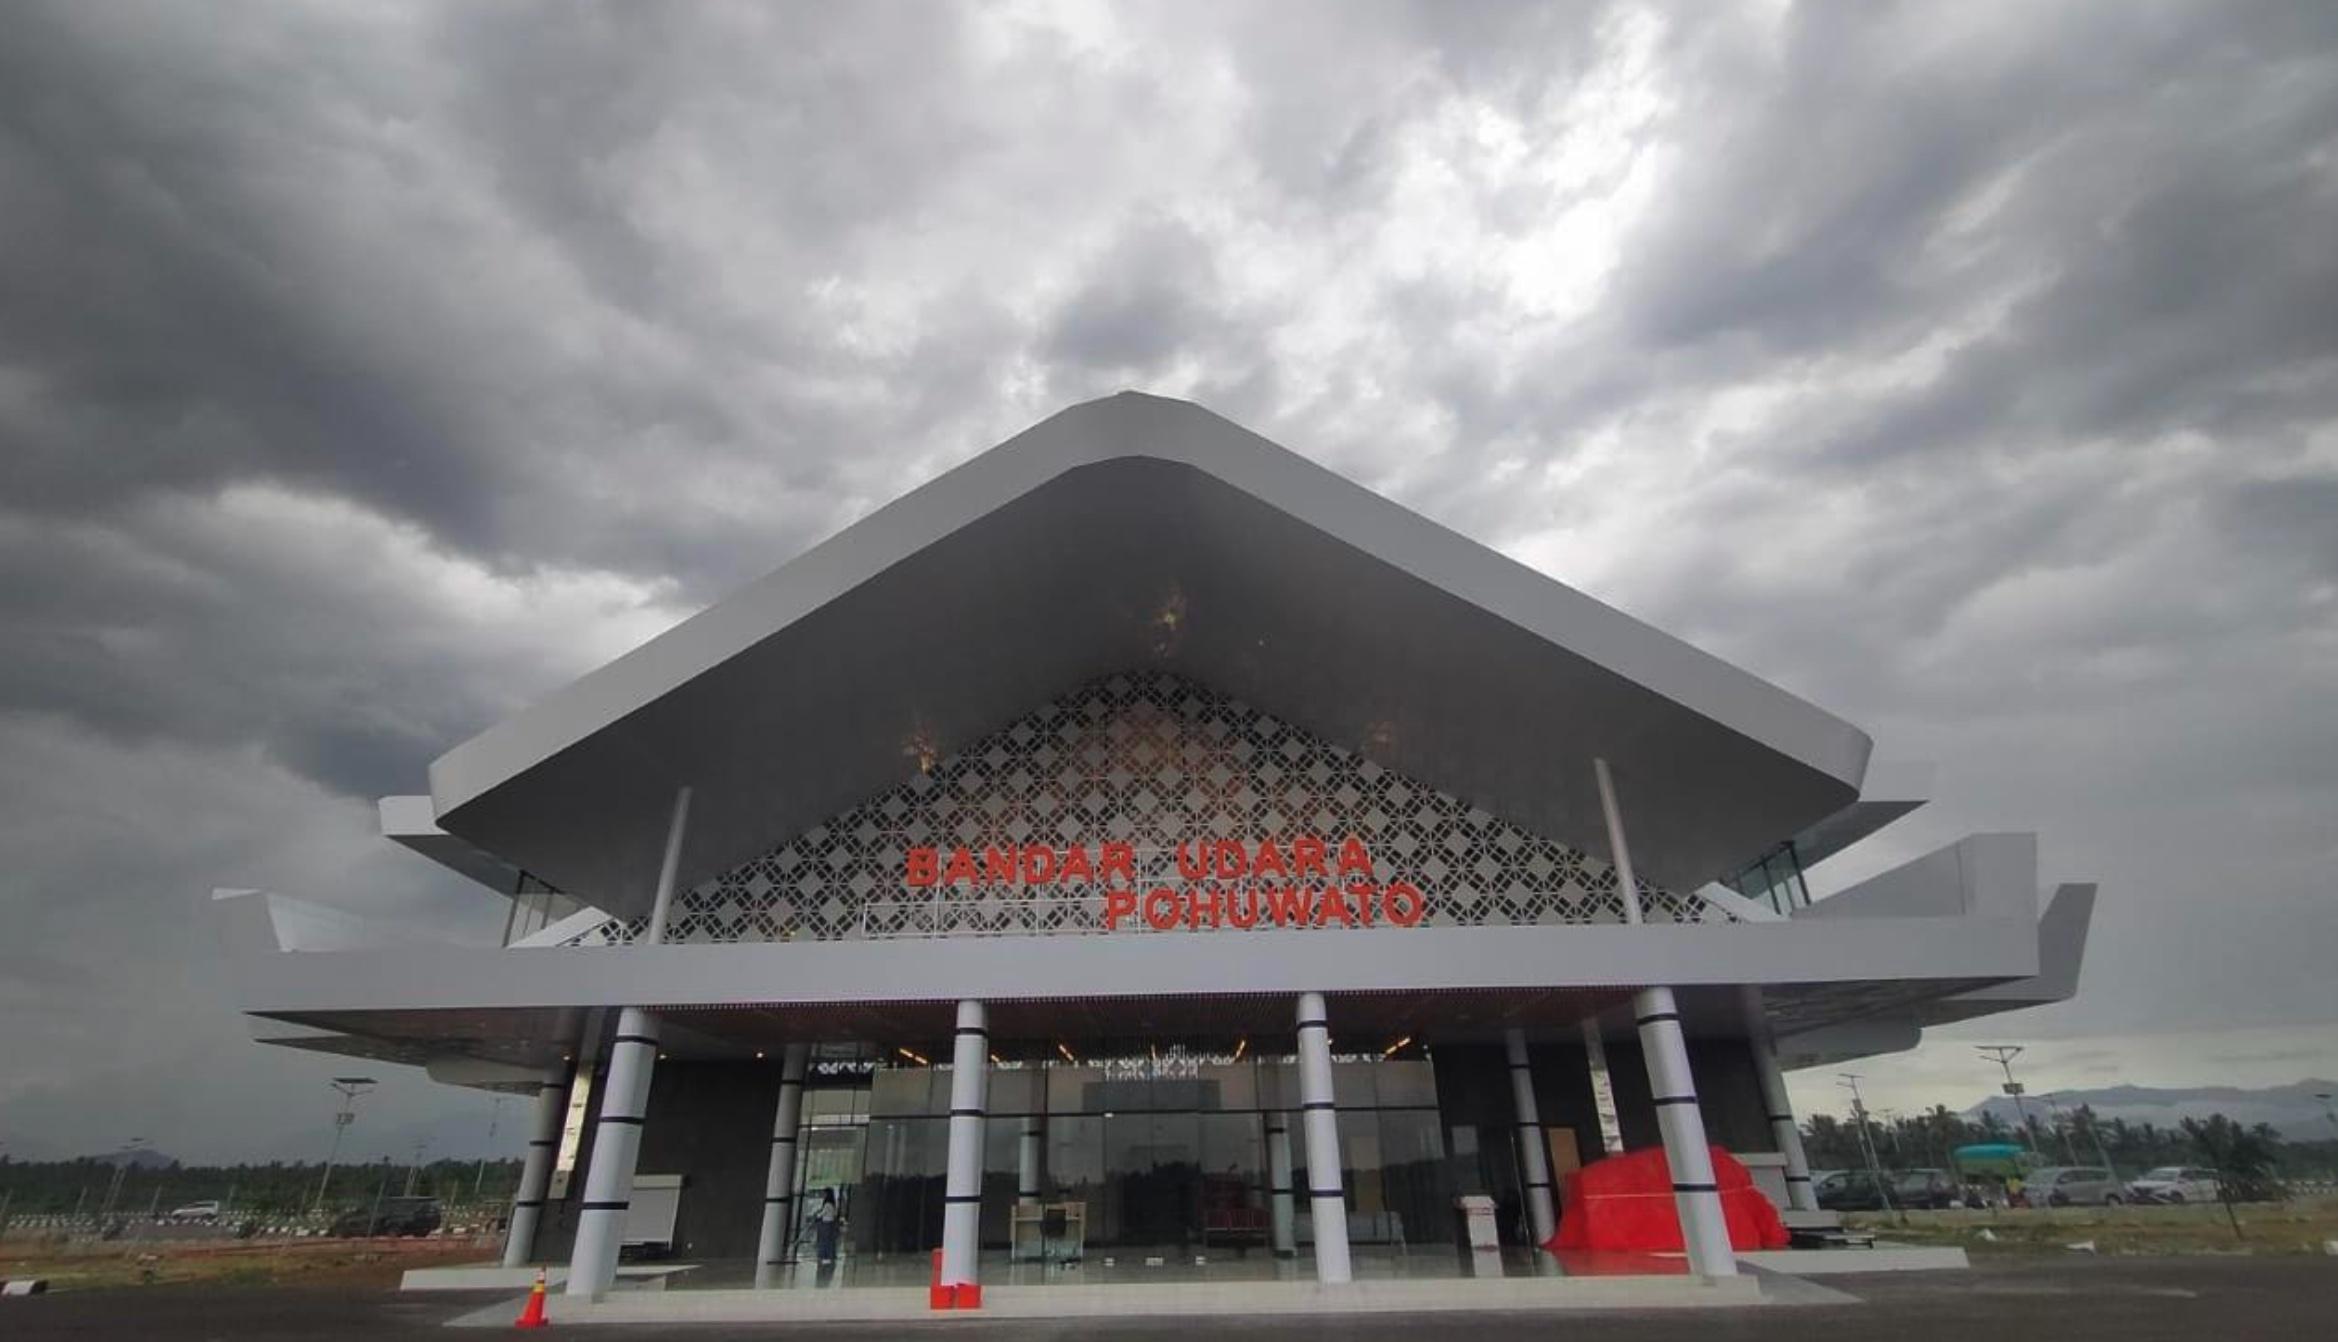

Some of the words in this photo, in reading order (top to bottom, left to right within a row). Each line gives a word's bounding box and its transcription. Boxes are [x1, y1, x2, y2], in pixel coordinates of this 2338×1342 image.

[906, 841, 1137, 887] BANDAR
[1176, 836, 1373, 881] UDARA
[1104, 881, 1425, 930] POHUWATO
